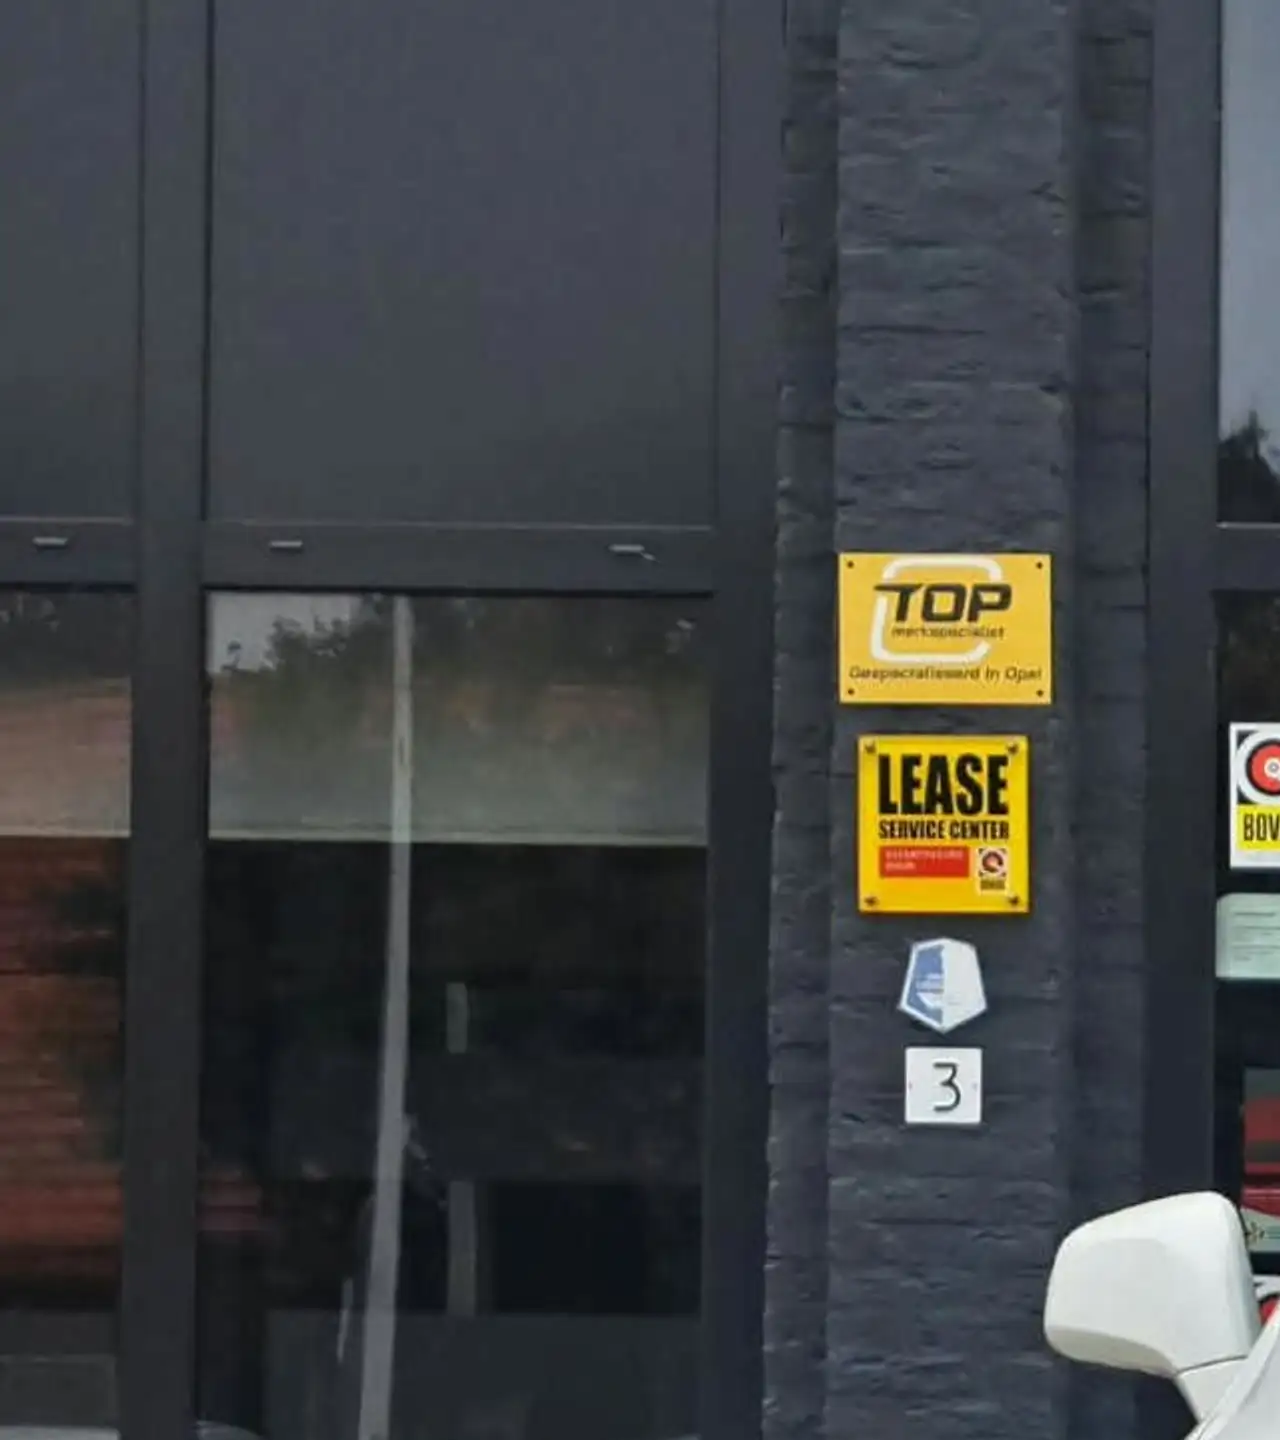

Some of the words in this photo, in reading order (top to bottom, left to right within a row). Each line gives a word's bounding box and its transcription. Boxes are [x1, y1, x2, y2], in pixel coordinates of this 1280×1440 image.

[873, 583, 1012, 623] TOP
[878, 754, 1009, 816] LEASE
[879, 820, 945, 839] SERVICE
[949, 820, 1009, 840] CENTER
[932, 1061, 961, 1112] 3
